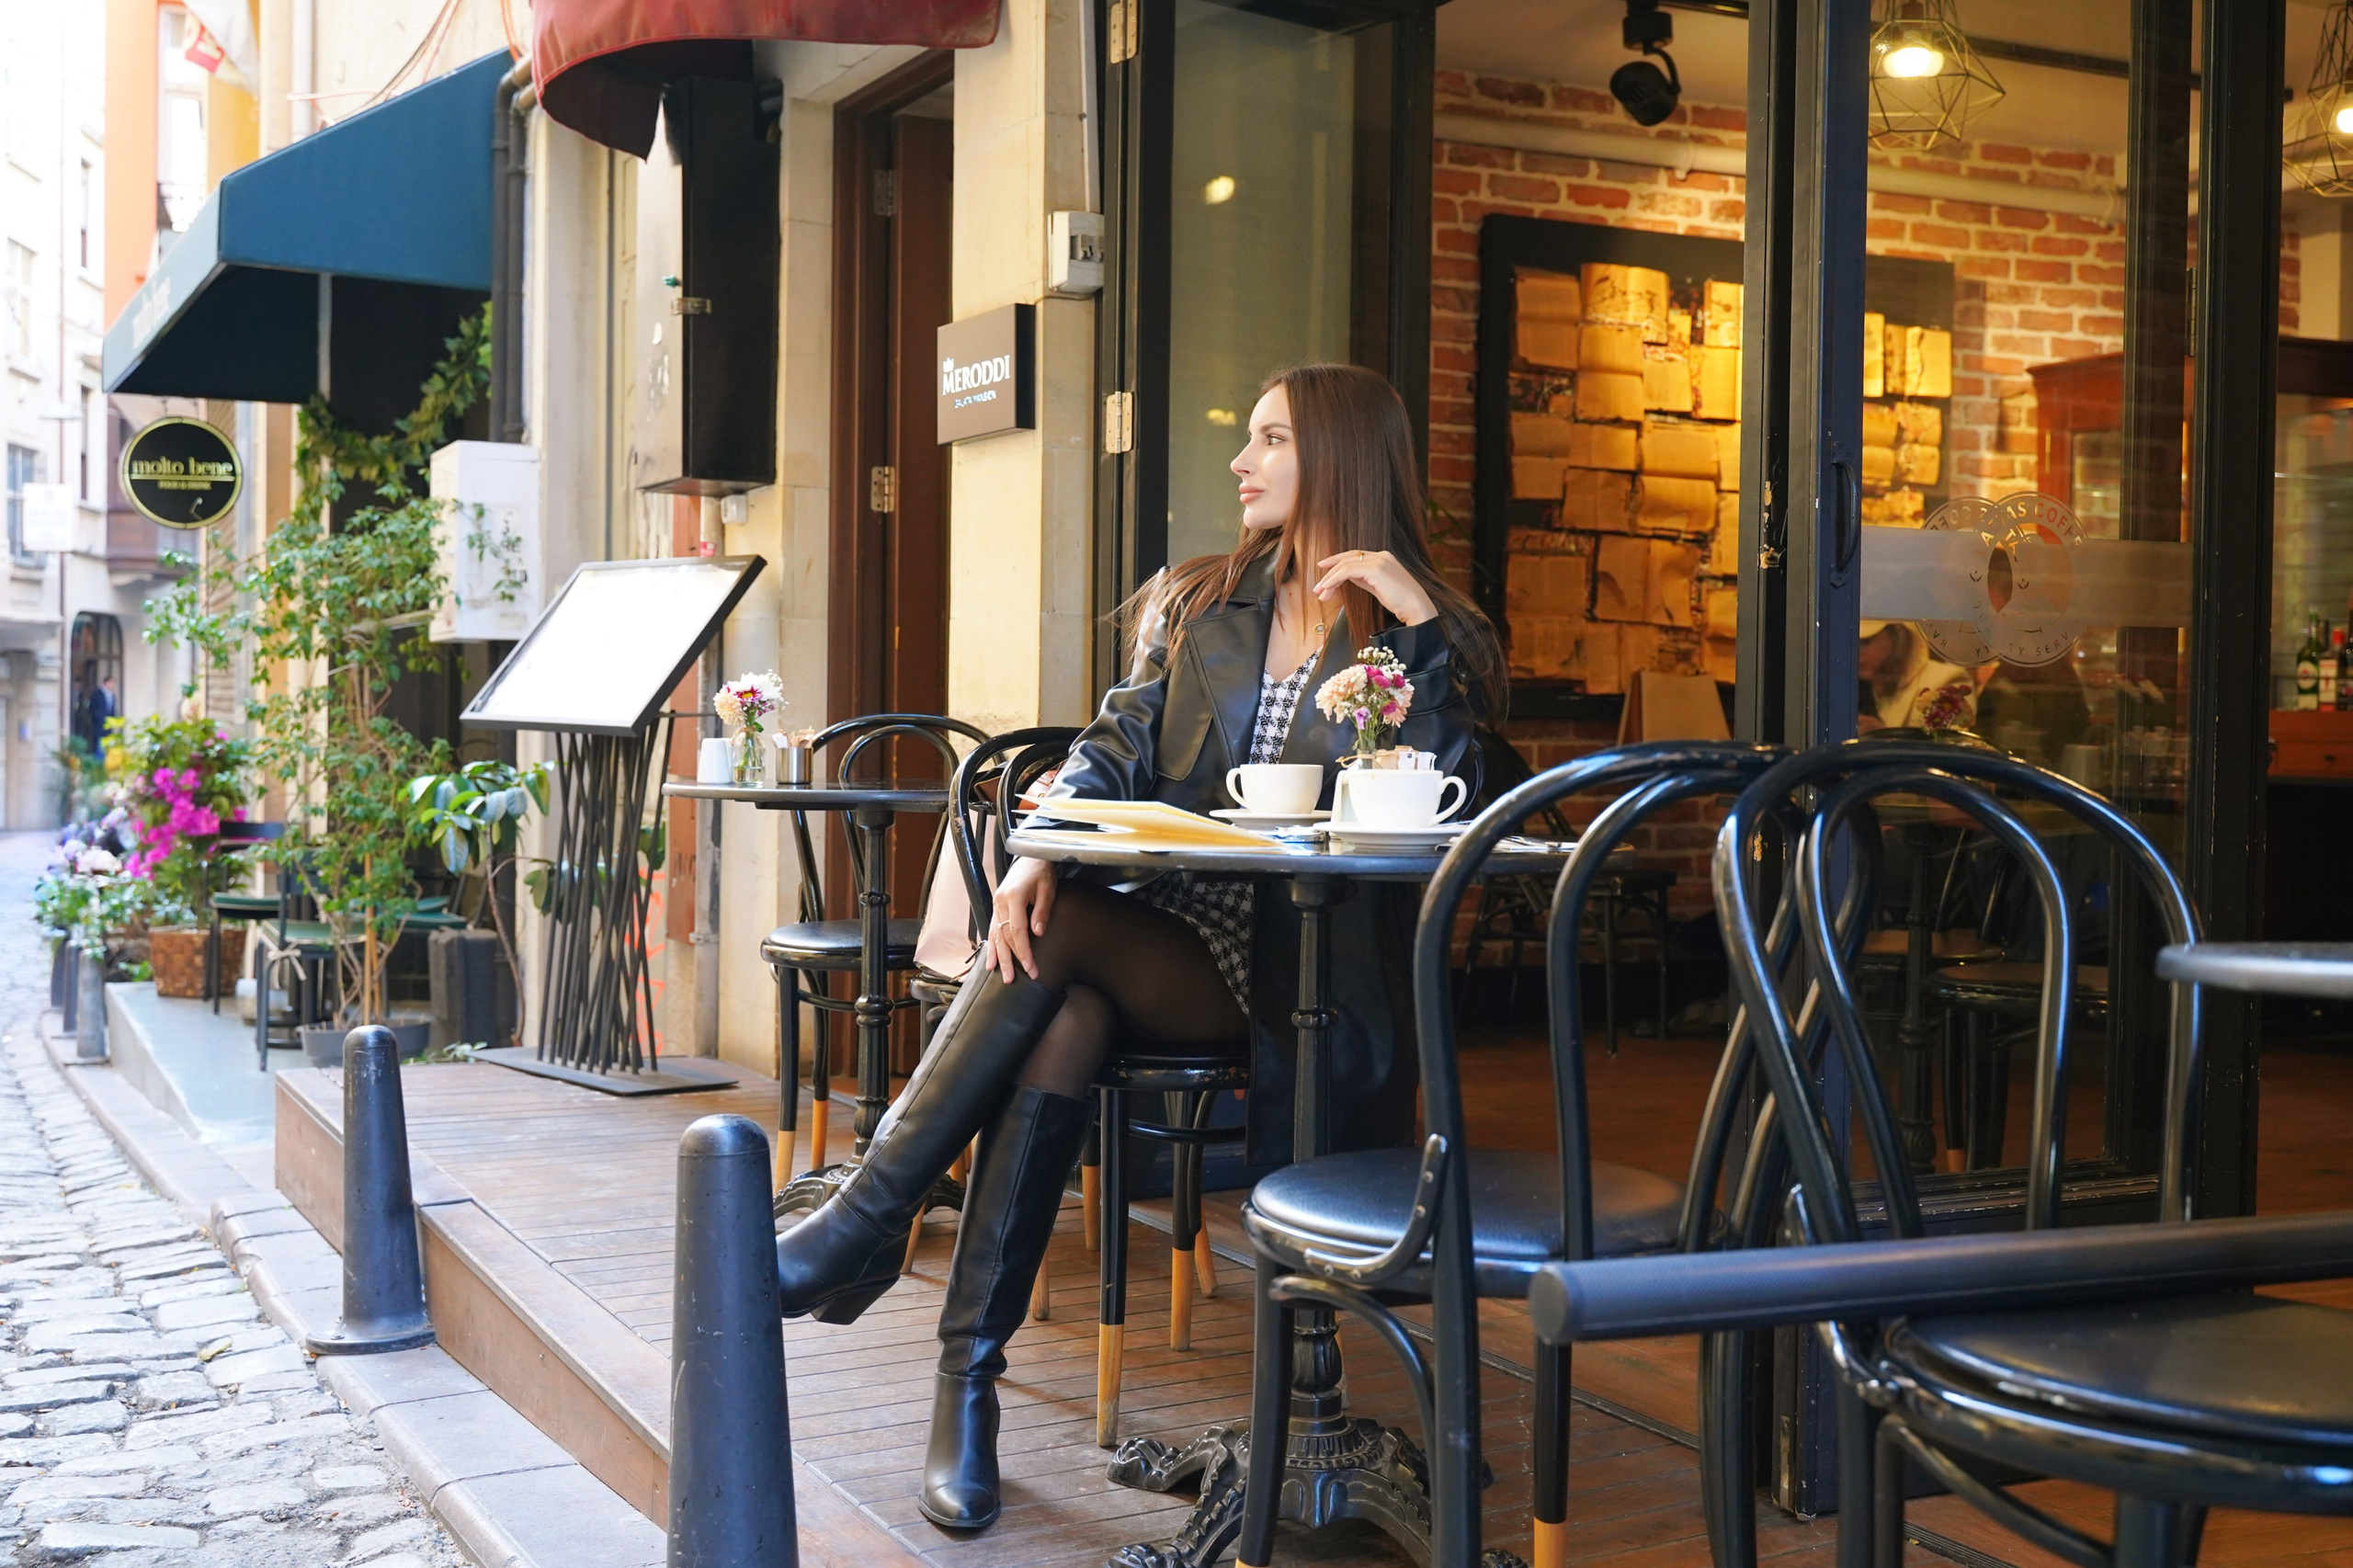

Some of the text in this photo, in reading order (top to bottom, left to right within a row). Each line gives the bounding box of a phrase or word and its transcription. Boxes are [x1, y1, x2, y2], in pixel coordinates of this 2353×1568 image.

[942, 355, 1010, 395] MERODDI
[131, 456, 233, 476] molto bene
